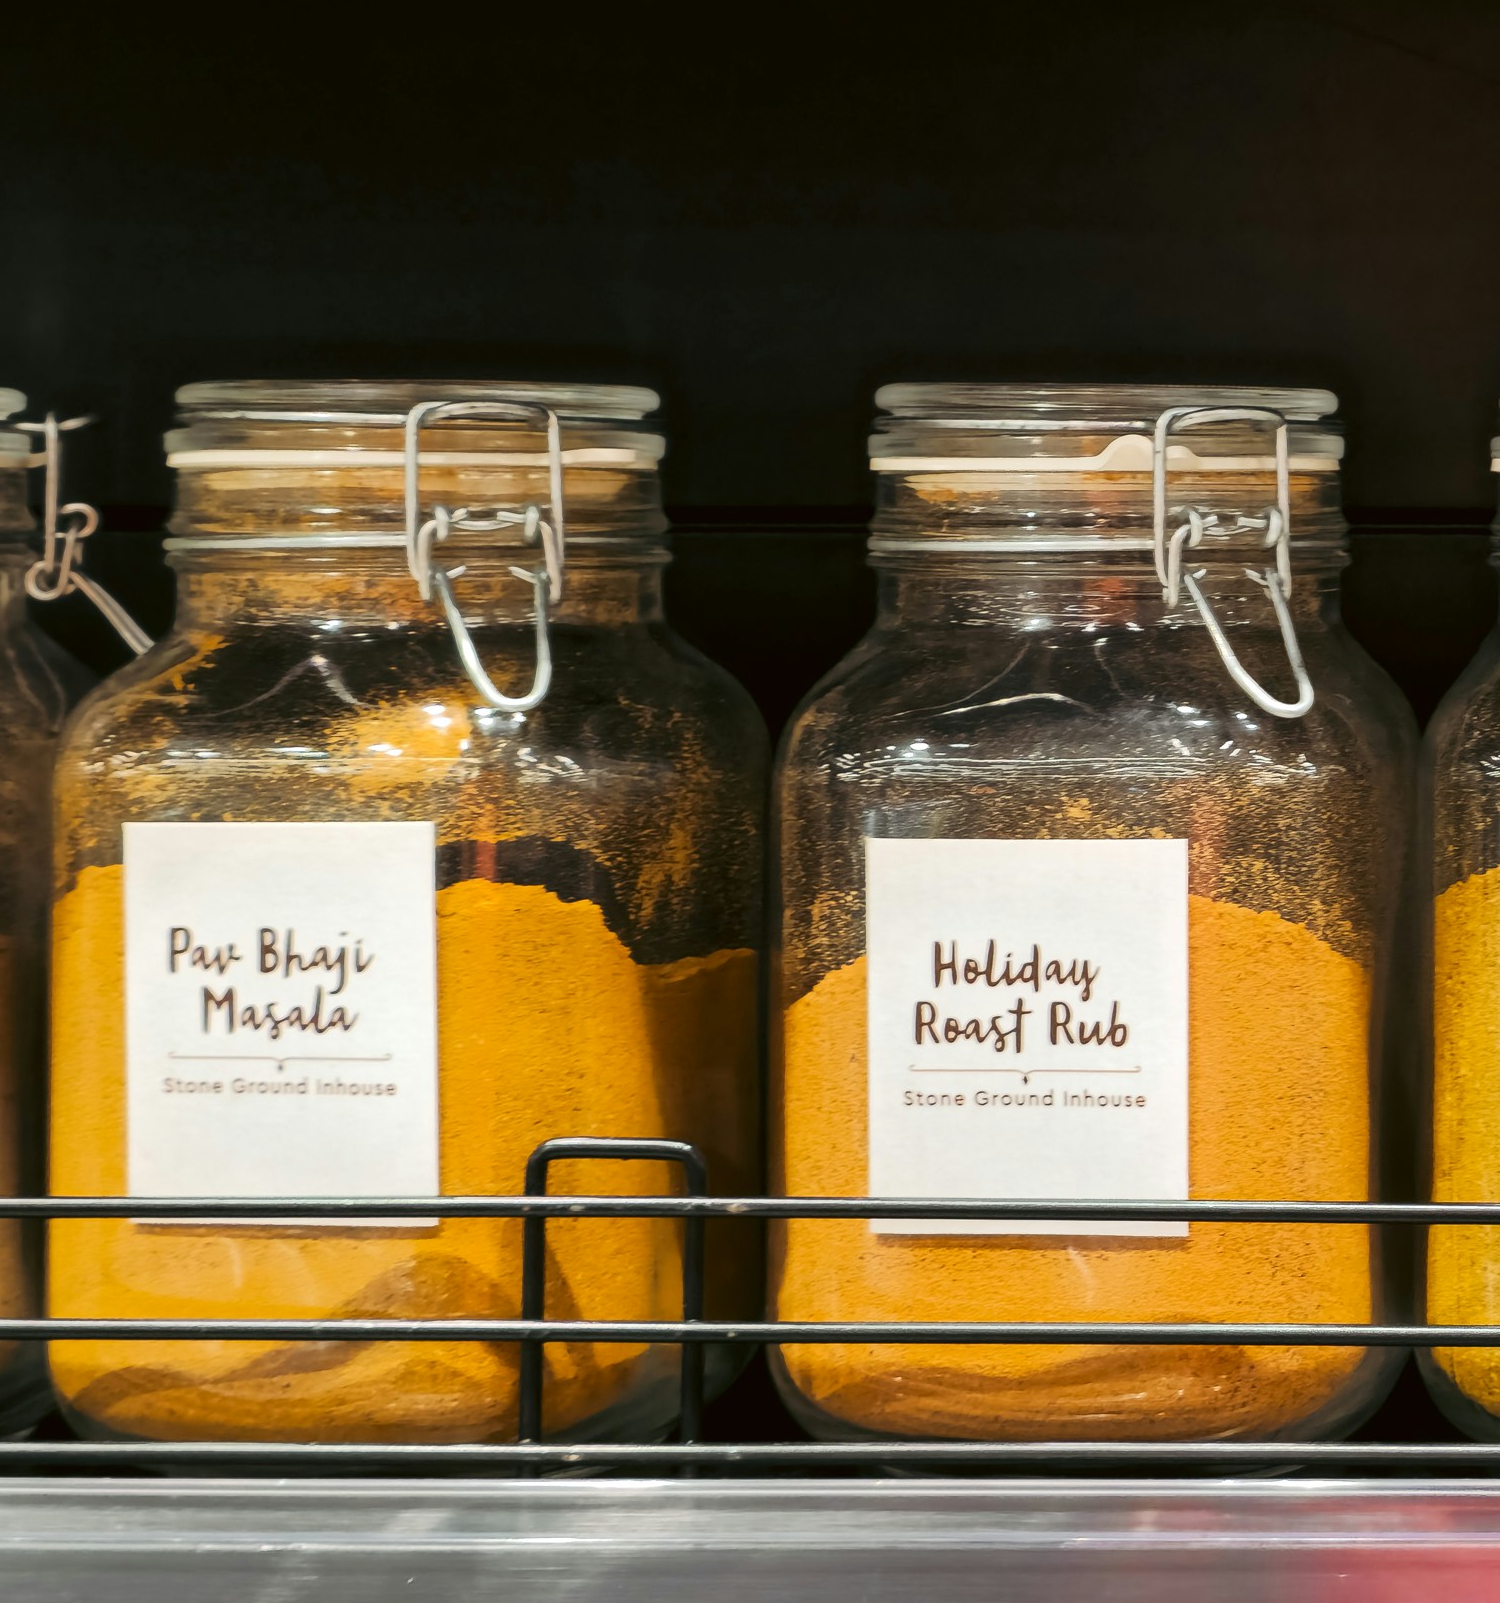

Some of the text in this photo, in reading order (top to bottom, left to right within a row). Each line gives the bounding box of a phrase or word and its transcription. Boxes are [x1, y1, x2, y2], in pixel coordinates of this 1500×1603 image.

[168, 927, 374, 997] Pav Bhaji
[932, 939, 1100, 1002] Holiday
[201, 981, 359, 1040] Masala
[914, 998, 1129, 1053] Roast Rub
[162, 1077, 397, 1096] Stone Ground Inhouse
[903, 1089, 1147, 1108] Stone Ground Inhouse
